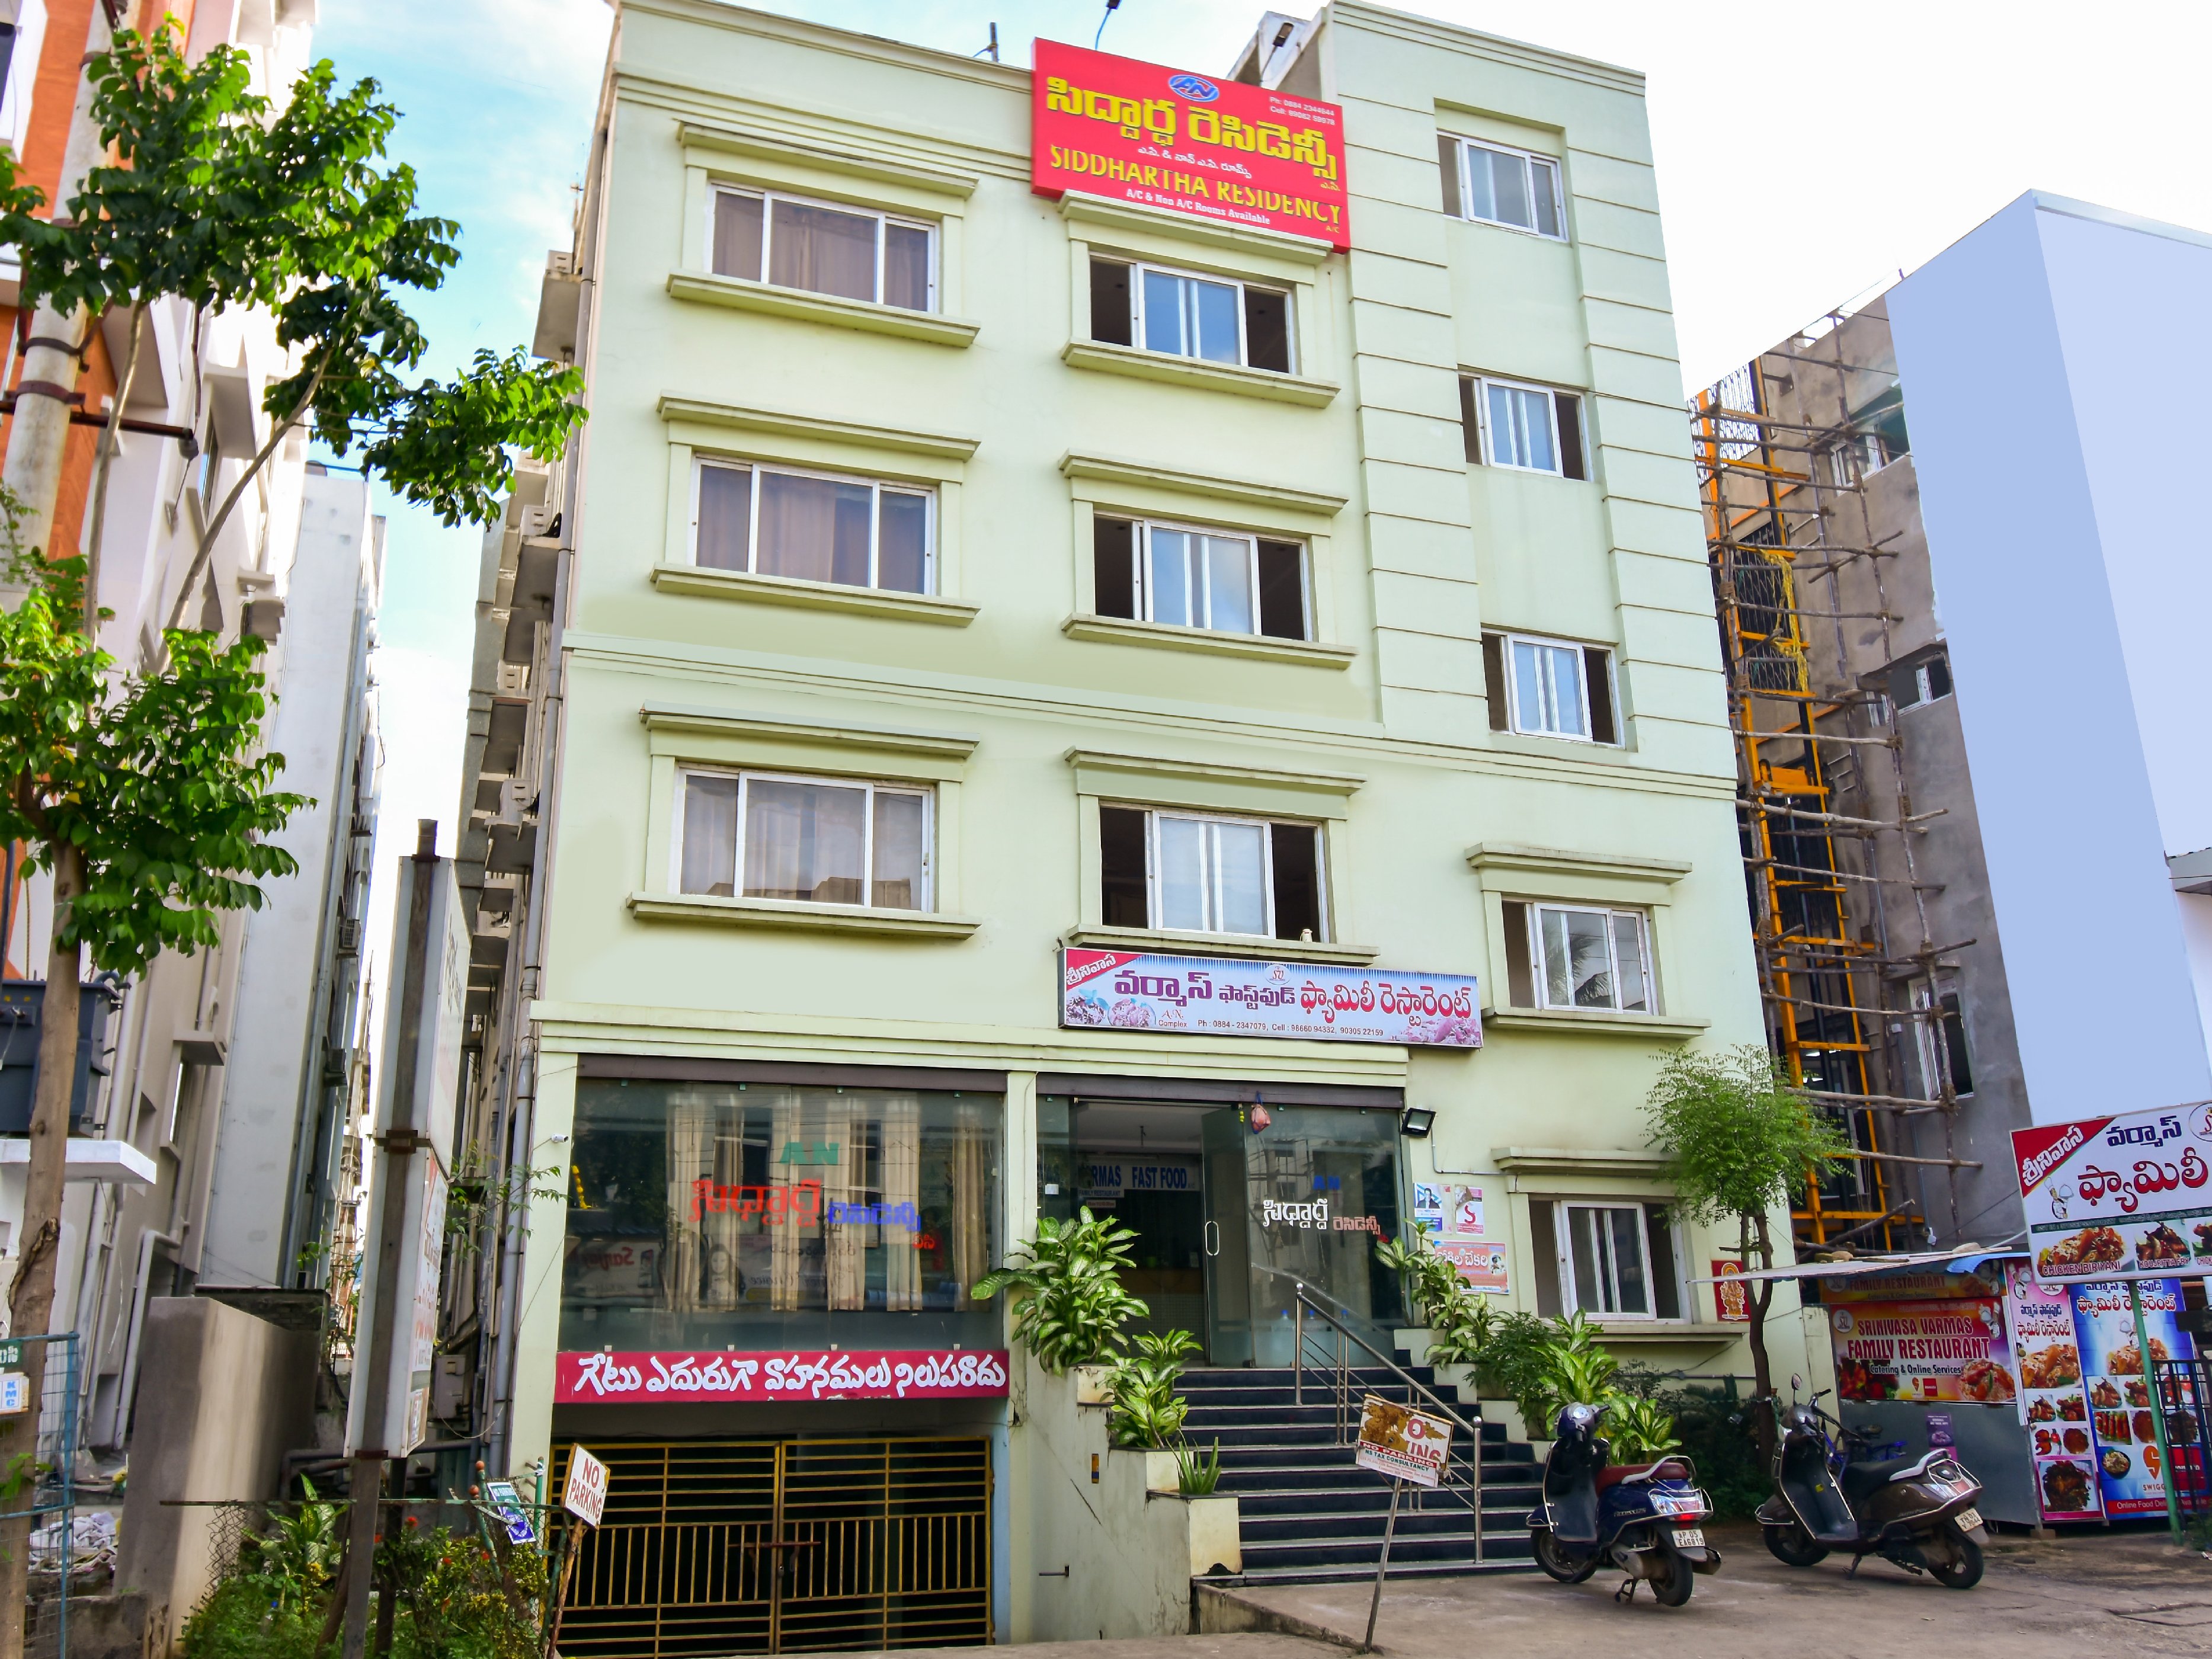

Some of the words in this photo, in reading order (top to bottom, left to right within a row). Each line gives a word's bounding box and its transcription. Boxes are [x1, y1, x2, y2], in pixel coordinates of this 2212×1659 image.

[1051, 144, 1209, 198] SIDDHARTHA
[1217, 180, 1342, 225] RESIDENCY
[1126, 188, 1143, 199] A/C
[1145, 191, 1154, 201] &
[1155, 194, 1174, 206] Non
[1176, 198, 1193, 210] A/C
[1195, 202, 1226, 216] Rooms
[1228, 208, 1270, 225] Available
[1158, 1019, 1188, 1028] Complex
[1212, 1020, 1230, 1028] 0884
[1291, 1024, 1313, 1033] 98660
[1340, 1027, 1362, 1035] 90305
[1363, 1028, 1384, 1036] 22159
[2105, 1114, 2183, 1148] వర్మాస్
[1078, 1164, 1122, 1187] RMAS
[1132, 1166, 1158, 1188] FAST
[1160, 1167, 1187, 1189] FOOD
[2077, 1146, 2210, 1213] ఫ్యామిలీ
[2043, 1263, 2082, 1275] CHICKEN
[2083, 1260, 2121, 1273] BIRIYANI
[2176, 1257, 2189, 1267] FRY
[1849, 1276, 1887, 1292] FAMILY
[1887, 1274, 1946, 1290] RESTAURANT
[1857, 1317, 1918, 1336] SRINIVASA
[1920, 1316, 1974, 1335] VARMAS
[1847, 1338, 1894, 1360] FAMILY
[1898, 1337, 1990, 1360] RESTAURANT
[574, 1353, 642, 1397] గేటు
[646, 1356, 758, 1392] ఎదురుగా
[764, 1354, 891, 1399] వాహనములు
[894, 1353, 1007, 1398] నిలుపరాదు
[1869, 1365, 1900, 1376] Catering
[1900, 1365, 1905, 1374] &
[1907, 1364, 1932, 1374] Online
[1932, 1364, 1962, 1375] Services
[1363, 1442, 1379, 1451] NO
[1382, 1447, 1435, 1467] PARKING
[1387, 1455, 1429, 1472] CONSULTANCY
[582, 1458, 600, 1489] NO
[569, 1478, 603, 1520] PARKING
[2117, 1501, 2137, 1509] Online
[2138, 1500, 2153, 1508] Food
